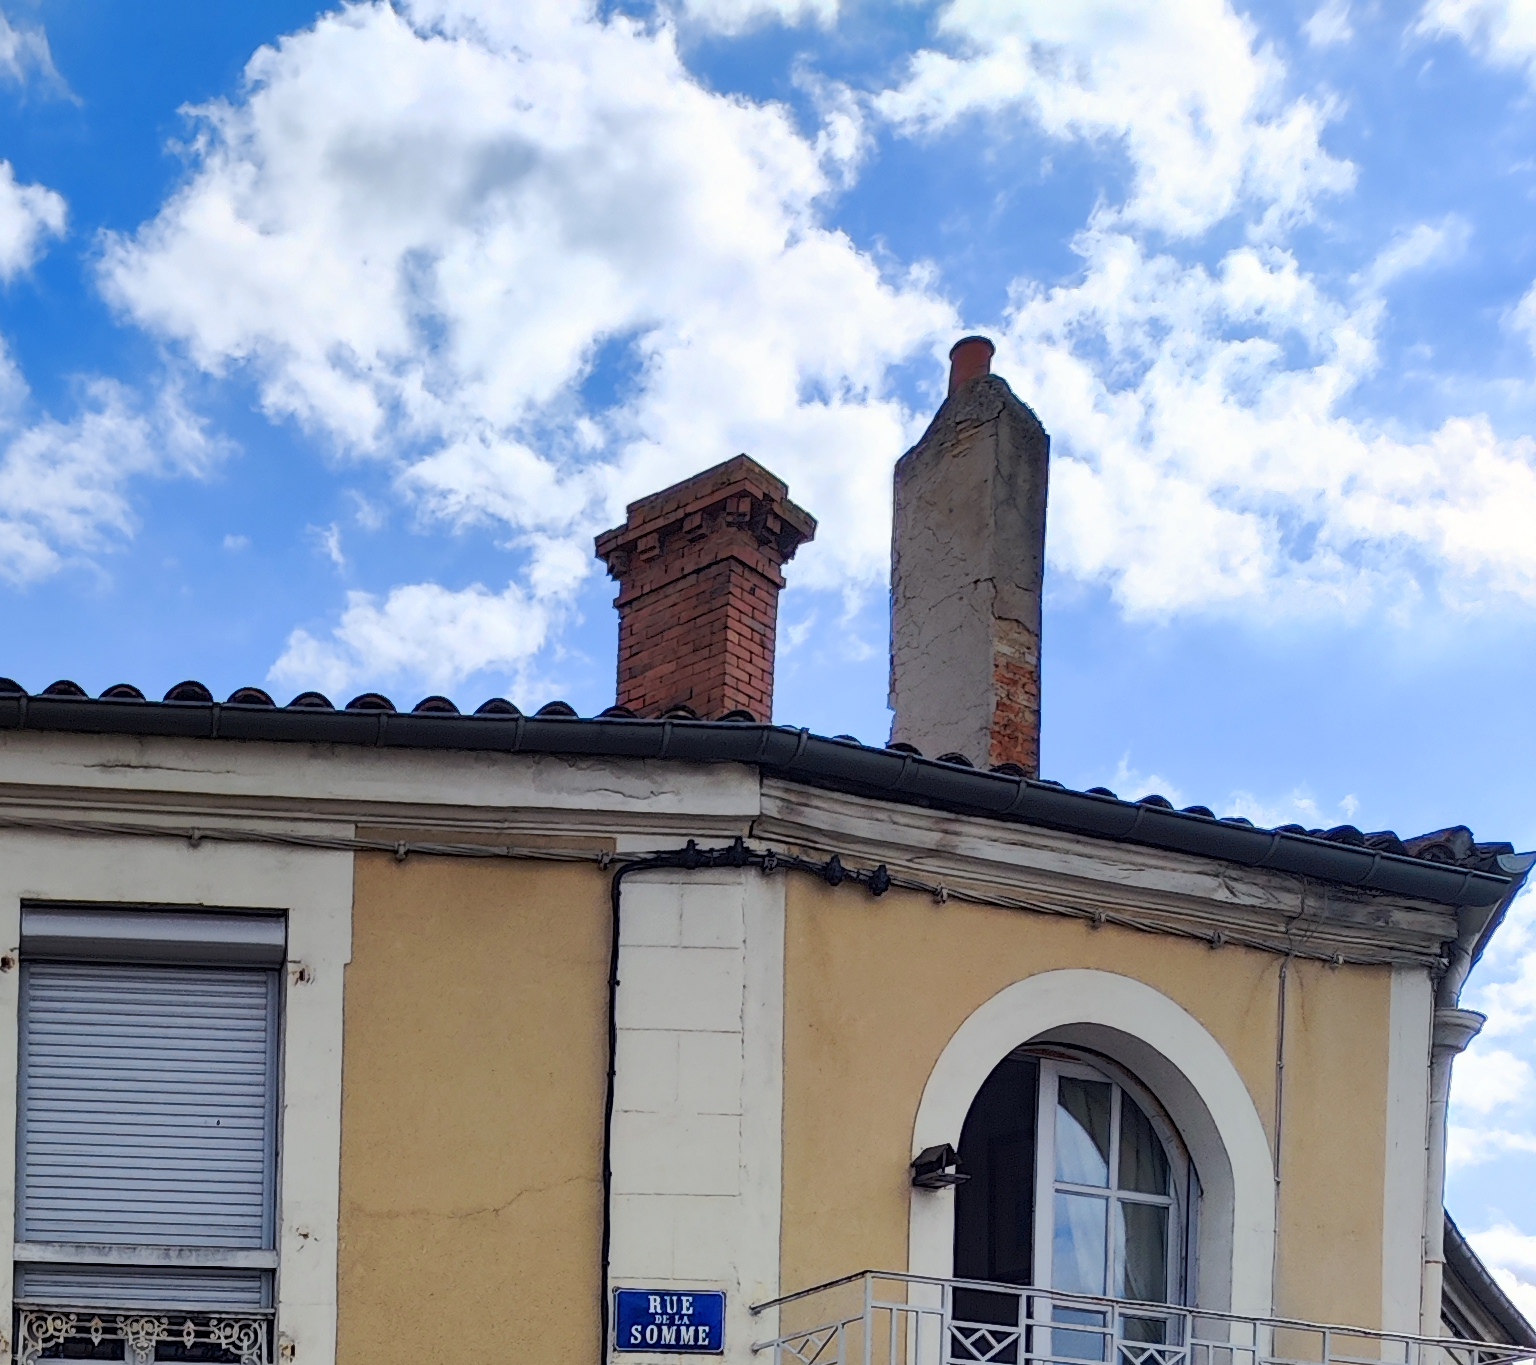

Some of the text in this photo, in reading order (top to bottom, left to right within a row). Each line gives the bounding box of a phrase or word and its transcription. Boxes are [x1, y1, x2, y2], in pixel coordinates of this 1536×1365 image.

[648, 1295, 693, 1314] RUE
[655, 1315, 690, 1325] DE LA
[630, 1325, 709, 1345] SOMME
